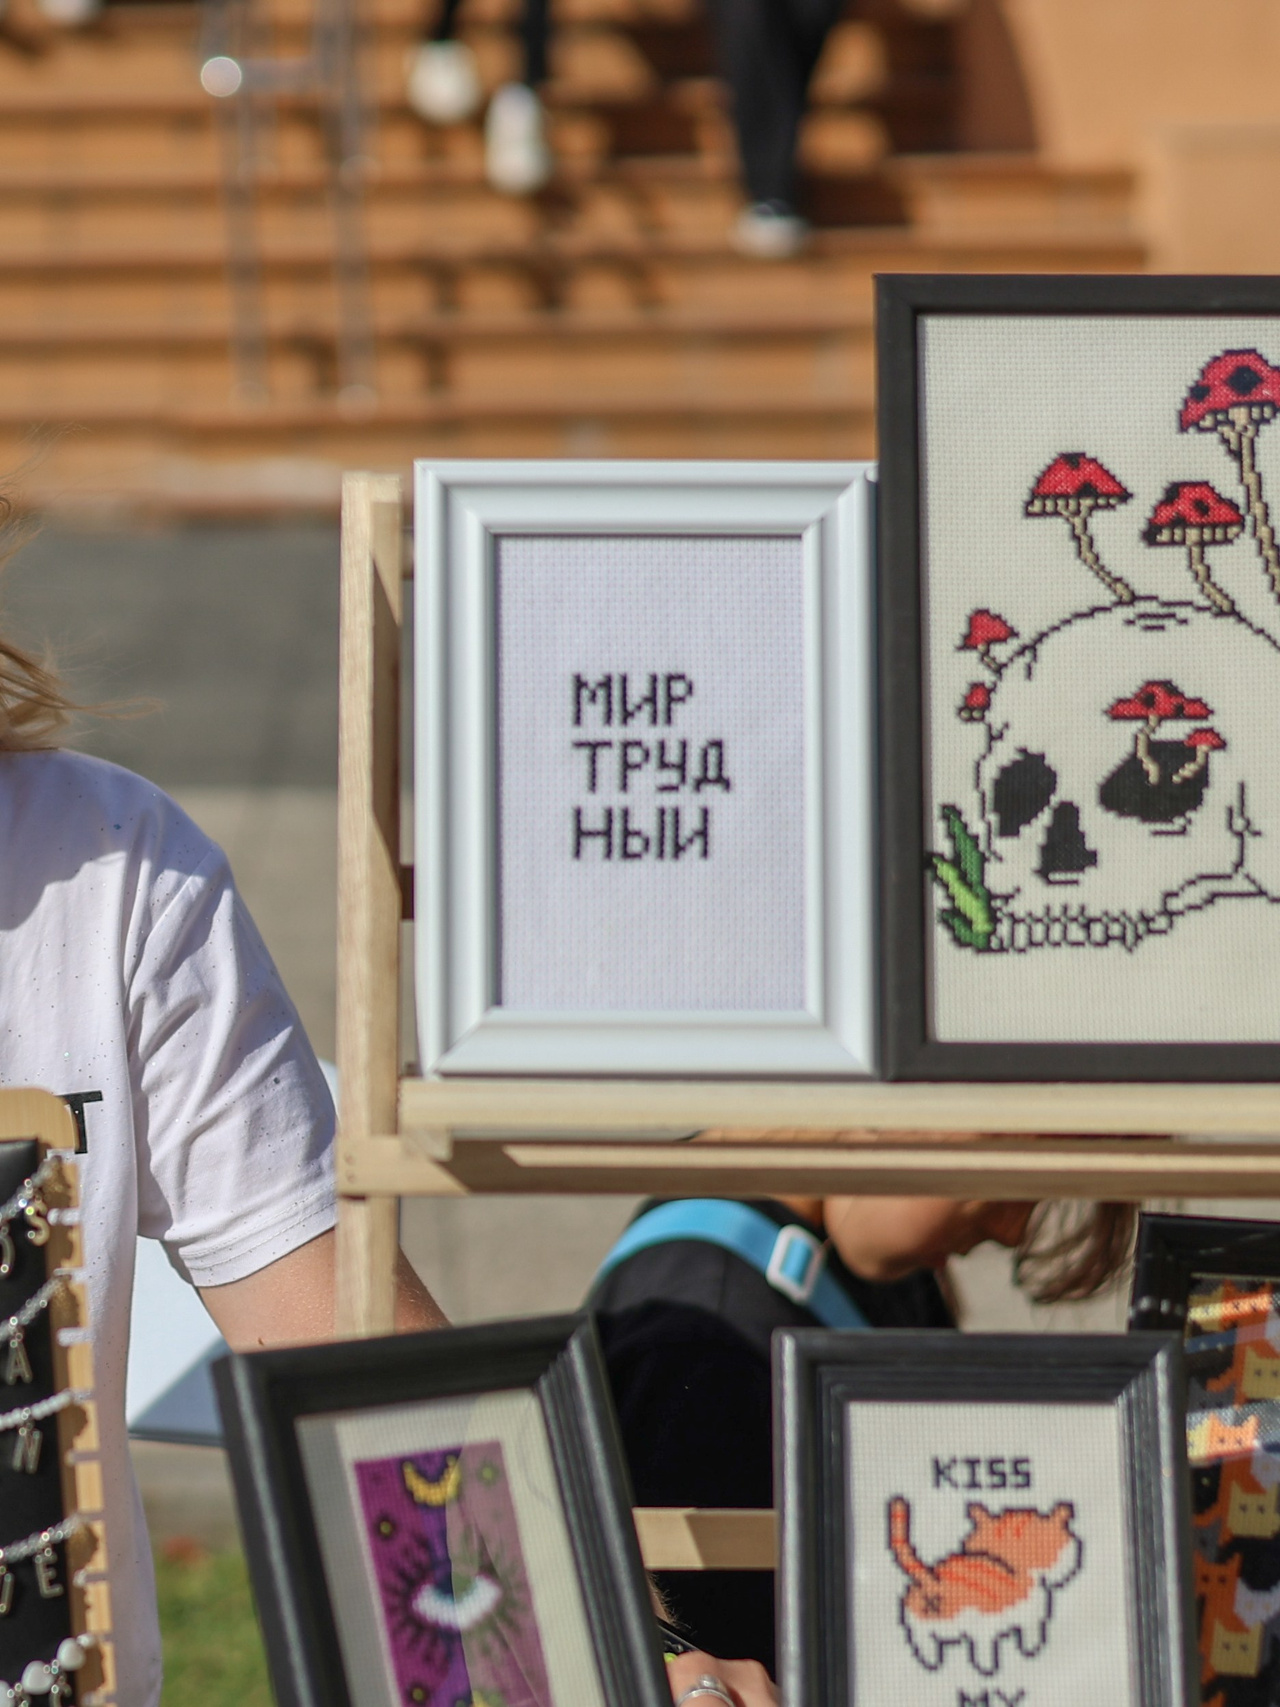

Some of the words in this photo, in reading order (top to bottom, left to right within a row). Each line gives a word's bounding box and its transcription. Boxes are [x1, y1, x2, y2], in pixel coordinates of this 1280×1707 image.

[573, 672, 693, 727] МИР
[572, 739, 732, 793] ТРУД
[932, 1457, 1032, 1488] KISS
